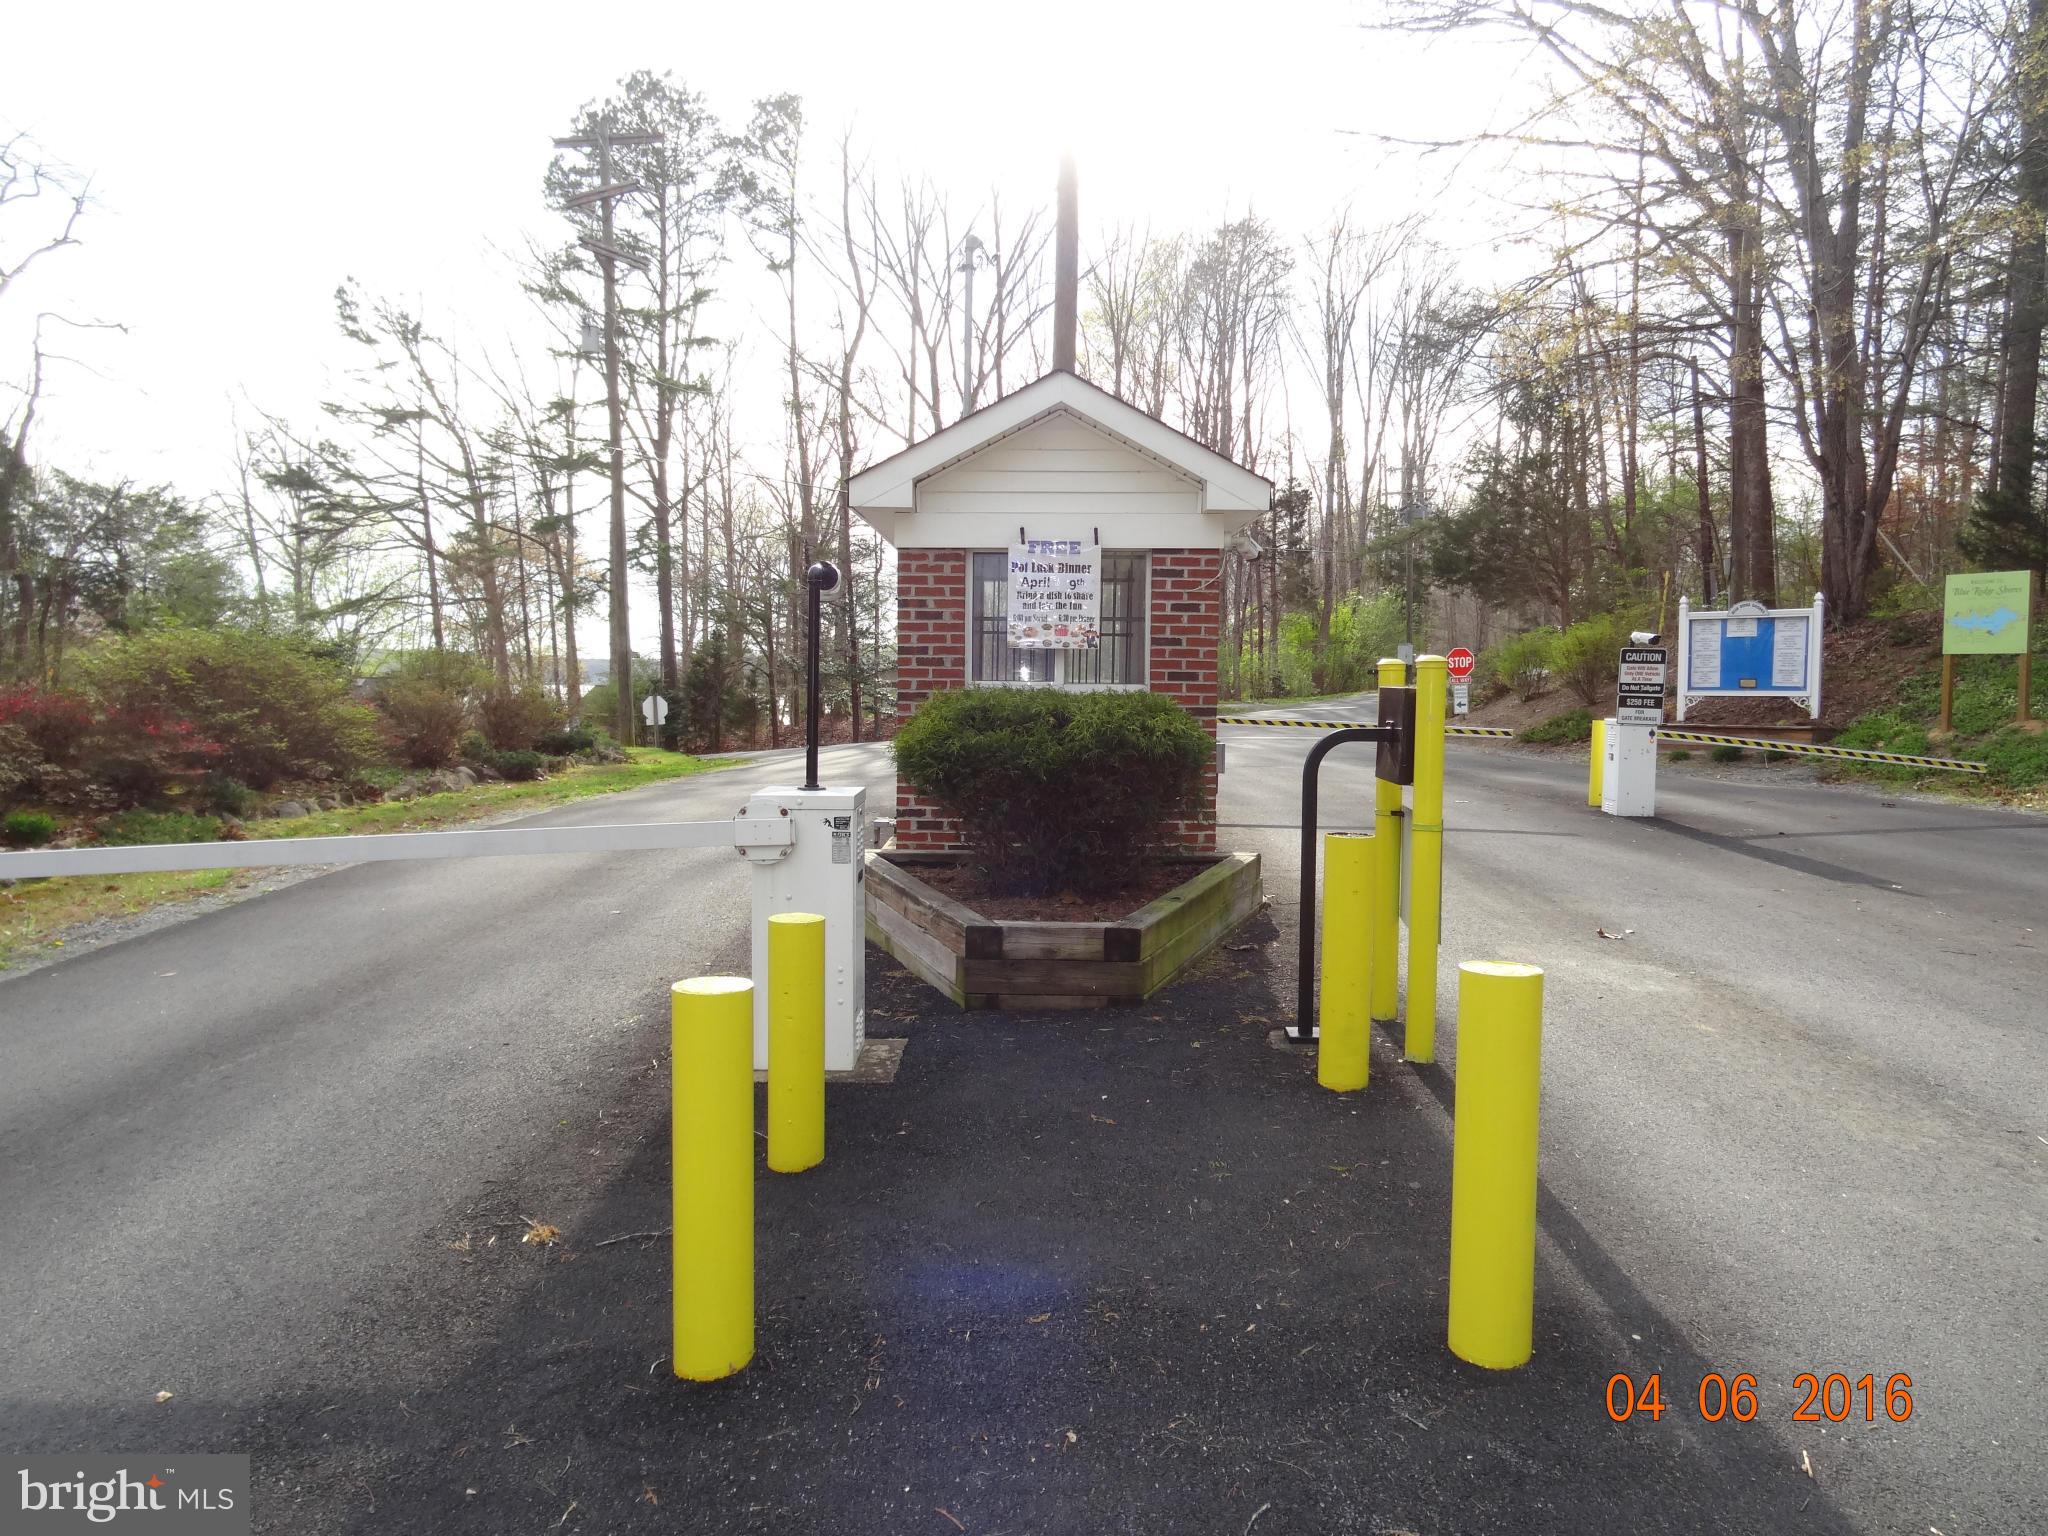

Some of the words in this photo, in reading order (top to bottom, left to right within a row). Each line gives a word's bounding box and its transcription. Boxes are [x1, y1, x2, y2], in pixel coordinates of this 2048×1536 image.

[1028, 540, 1081, 554] FREE
[1011, 562, 1028, 573] Pot
[1032, 562, 1055, 573] Luck
[1058, 562, 1092, 574] Dinner
[1021, 577, 1050, 589] April
[1069, 578, 1085, 590] 9th
[1016, 591, 1038, 601] Bring
[1039, 592, 1044, 600] a
[1046, 591, 1062, 600] dish
[1064, 591, 1072, 600] to
[1073, 591, 1094, 600] share
[1023, 602, 1036, 610] and
[1055, 602, 1068, 610] the
[1069, 602, 1082, 610] fun
[1625, 652, 1662, 662] CAUTION
[1448, 656, 1472, 669] STOP
[1640, 684, 1661, 692] Tailgate
[1626, 698, 1642, 706] $250
[1643, 699, 1655, 707] FEE
